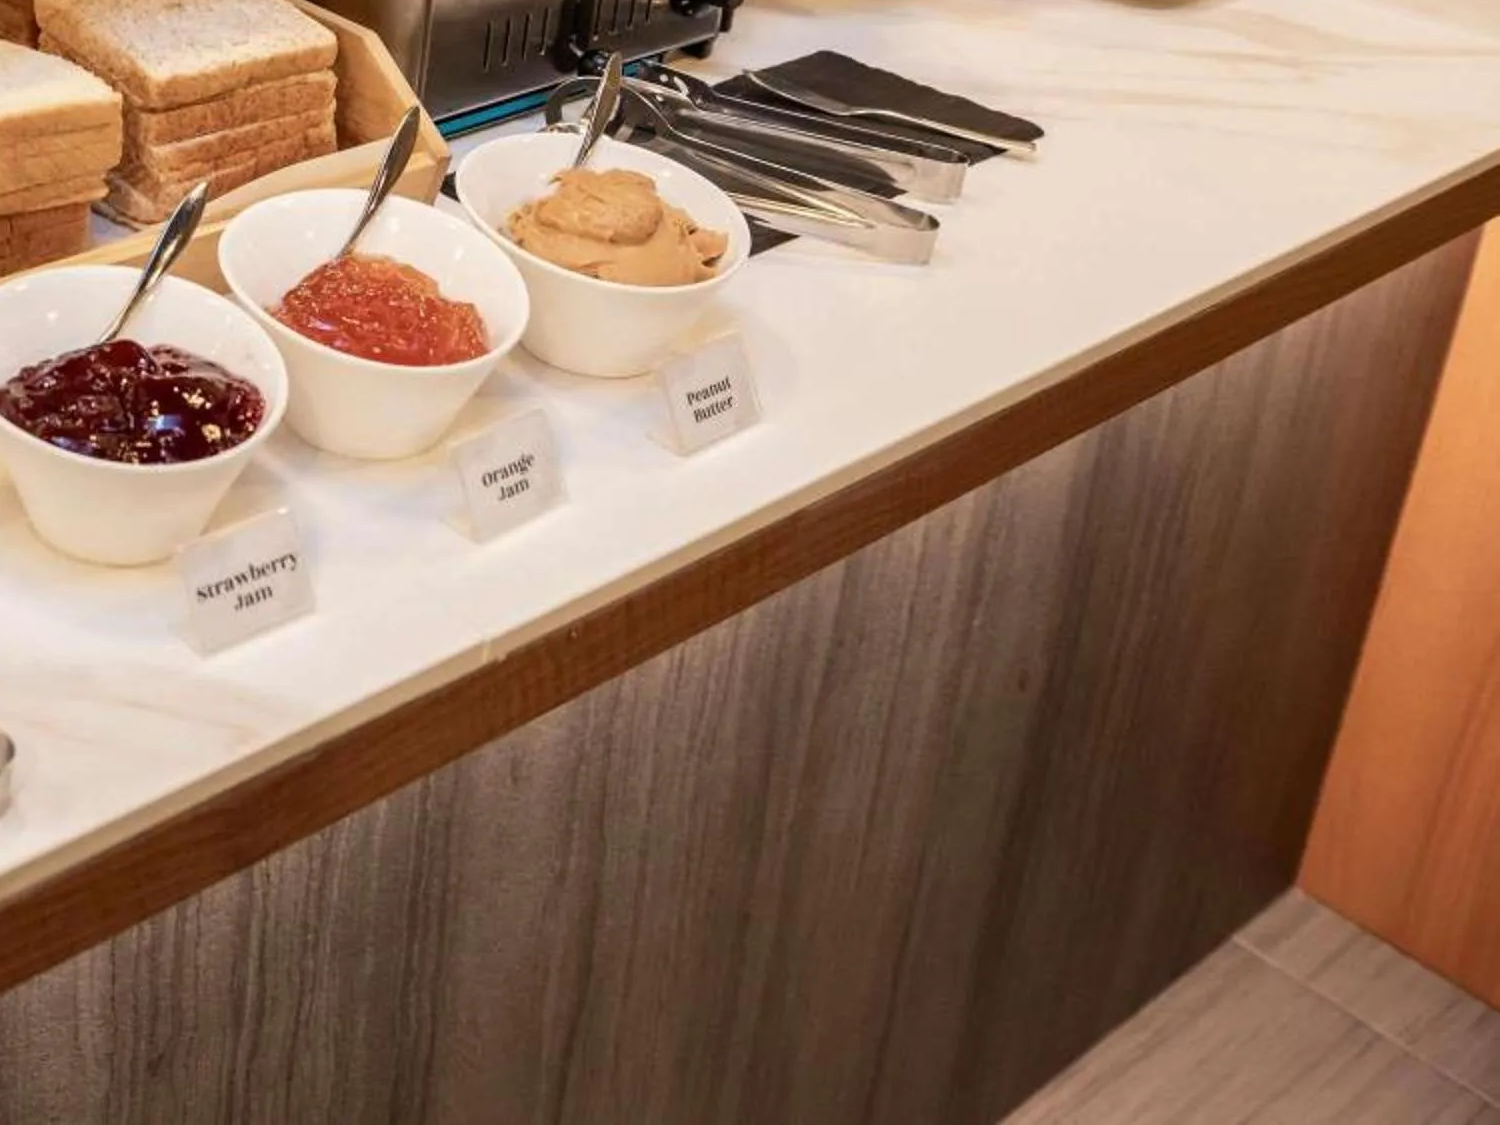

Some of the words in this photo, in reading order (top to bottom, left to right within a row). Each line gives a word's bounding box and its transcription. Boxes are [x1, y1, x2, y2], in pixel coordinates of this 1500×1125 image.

[686, 375, 732, 406] Peanut
[693, 396, 733, 423] Butter
[481, 453, 535, 488] Orange
[497, 478, 531, 502] Jam
[196, 553, 298, 602] Strawberry
[233, 585, 274, 611] Jam
